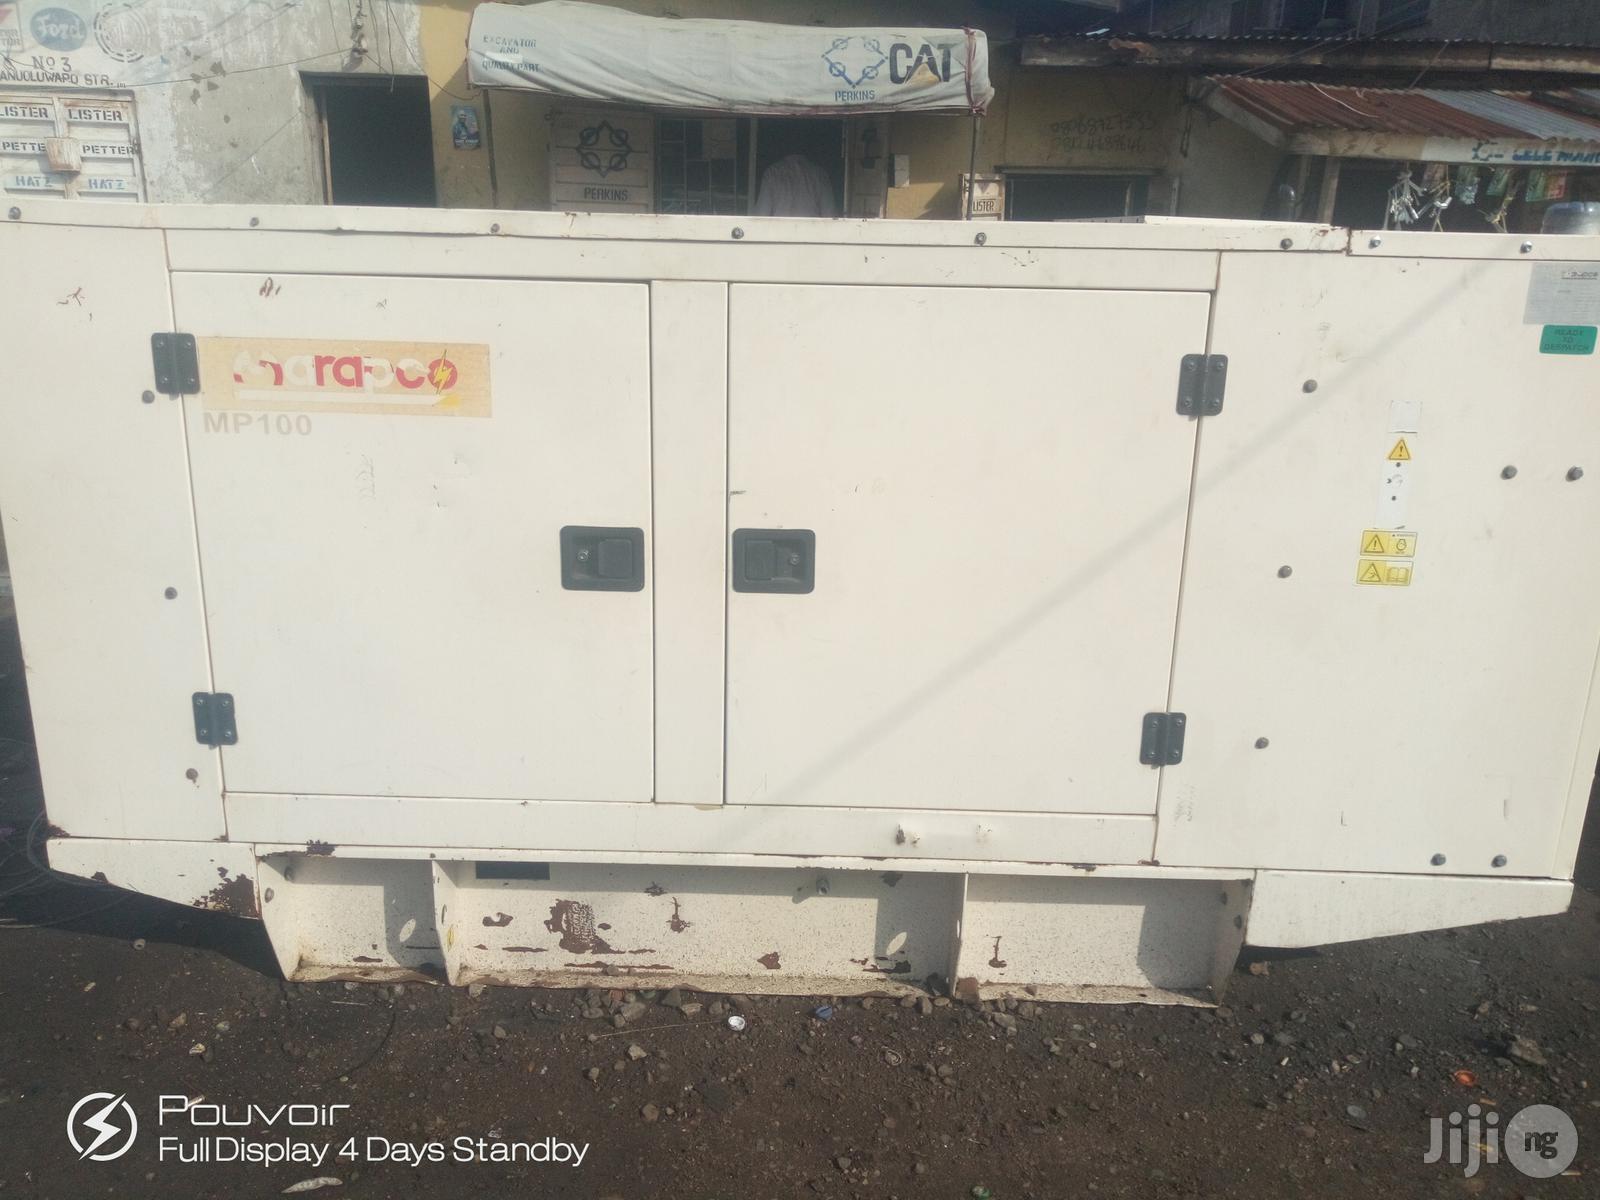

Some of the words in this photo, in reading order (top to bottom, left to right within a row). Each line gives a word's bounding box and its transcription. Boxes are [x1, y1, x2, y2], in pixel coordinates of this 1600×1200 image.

[61, 56, 72, 73] 3
[889, 43, 952, 84] CAT
[84, 75, 114, 87] STR.
[835, 90, 876, 102] PERKINS
[0, 106, 49, 118] ISTER
[68, 109, 123, 121] LISTER
[2, 142, 48, 152] PETTE
[82, 145, 137, 155] PETTER
[88, 178, 127, 190] HATZ
[584, 187, 629, 201] PERKINS
[973, 200, 995, 212] LISTER
[204, 412, 312, 436] MP100
